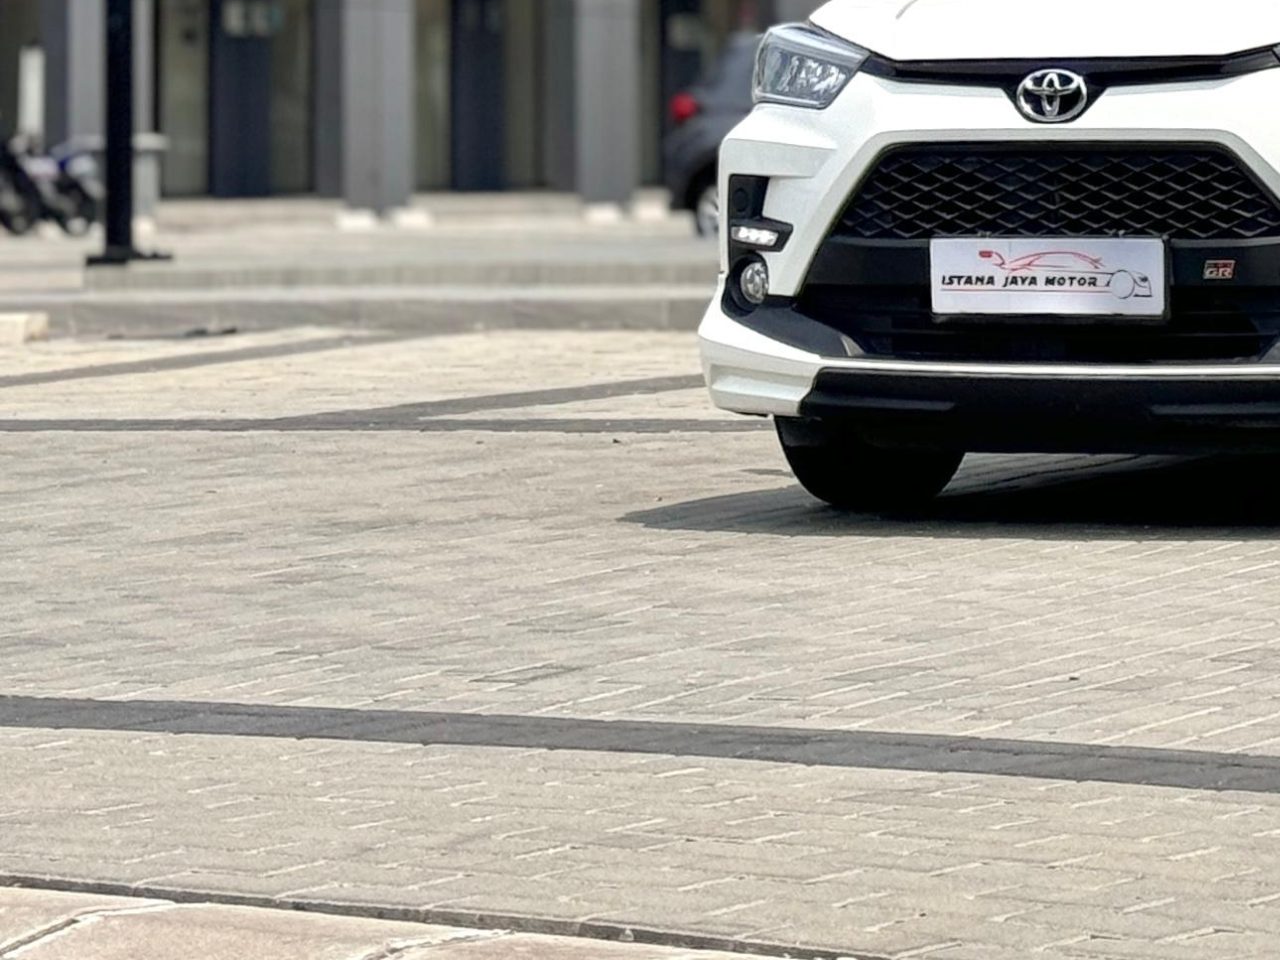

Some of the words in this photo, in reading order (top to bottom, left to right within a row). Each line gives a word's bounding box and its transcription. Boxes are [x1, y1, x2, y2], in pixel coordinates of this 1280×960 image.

[941, 274, 995, 287] ISTANA
[1002, 275, 1038, 288] JAYA
[1044, 276, 1098, 288] MOTOR
